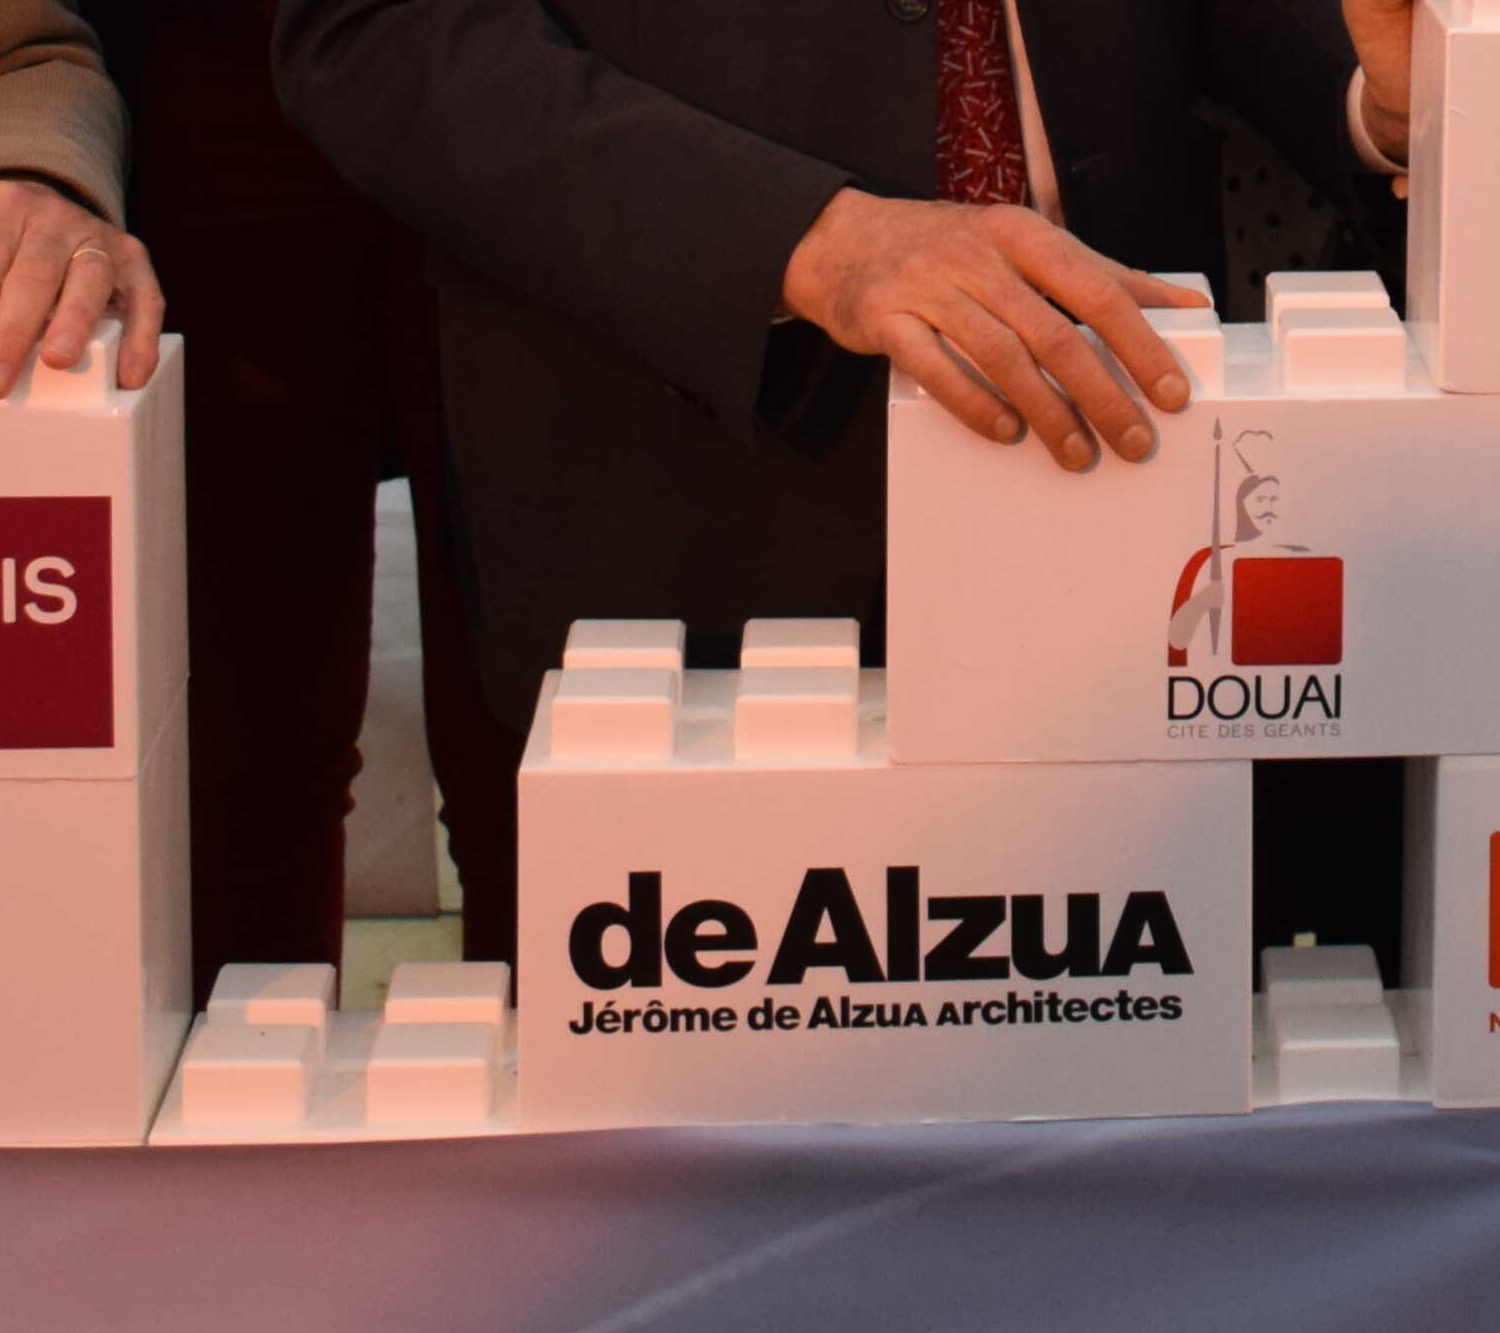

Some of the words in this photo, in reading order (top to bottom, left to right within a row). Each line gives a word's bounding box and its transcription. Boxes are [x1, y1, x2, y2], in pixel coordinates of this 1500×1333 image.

[1167, 674, 1342, 721] DOUAI
[1218, 723, 1256, 739] DES
[568, 870, 758, 990] de
[568, 995, 738, 1037] Jérôme
[747, 995, 801, 1031] de
[937, 987, 1183, 1027] Architectes
